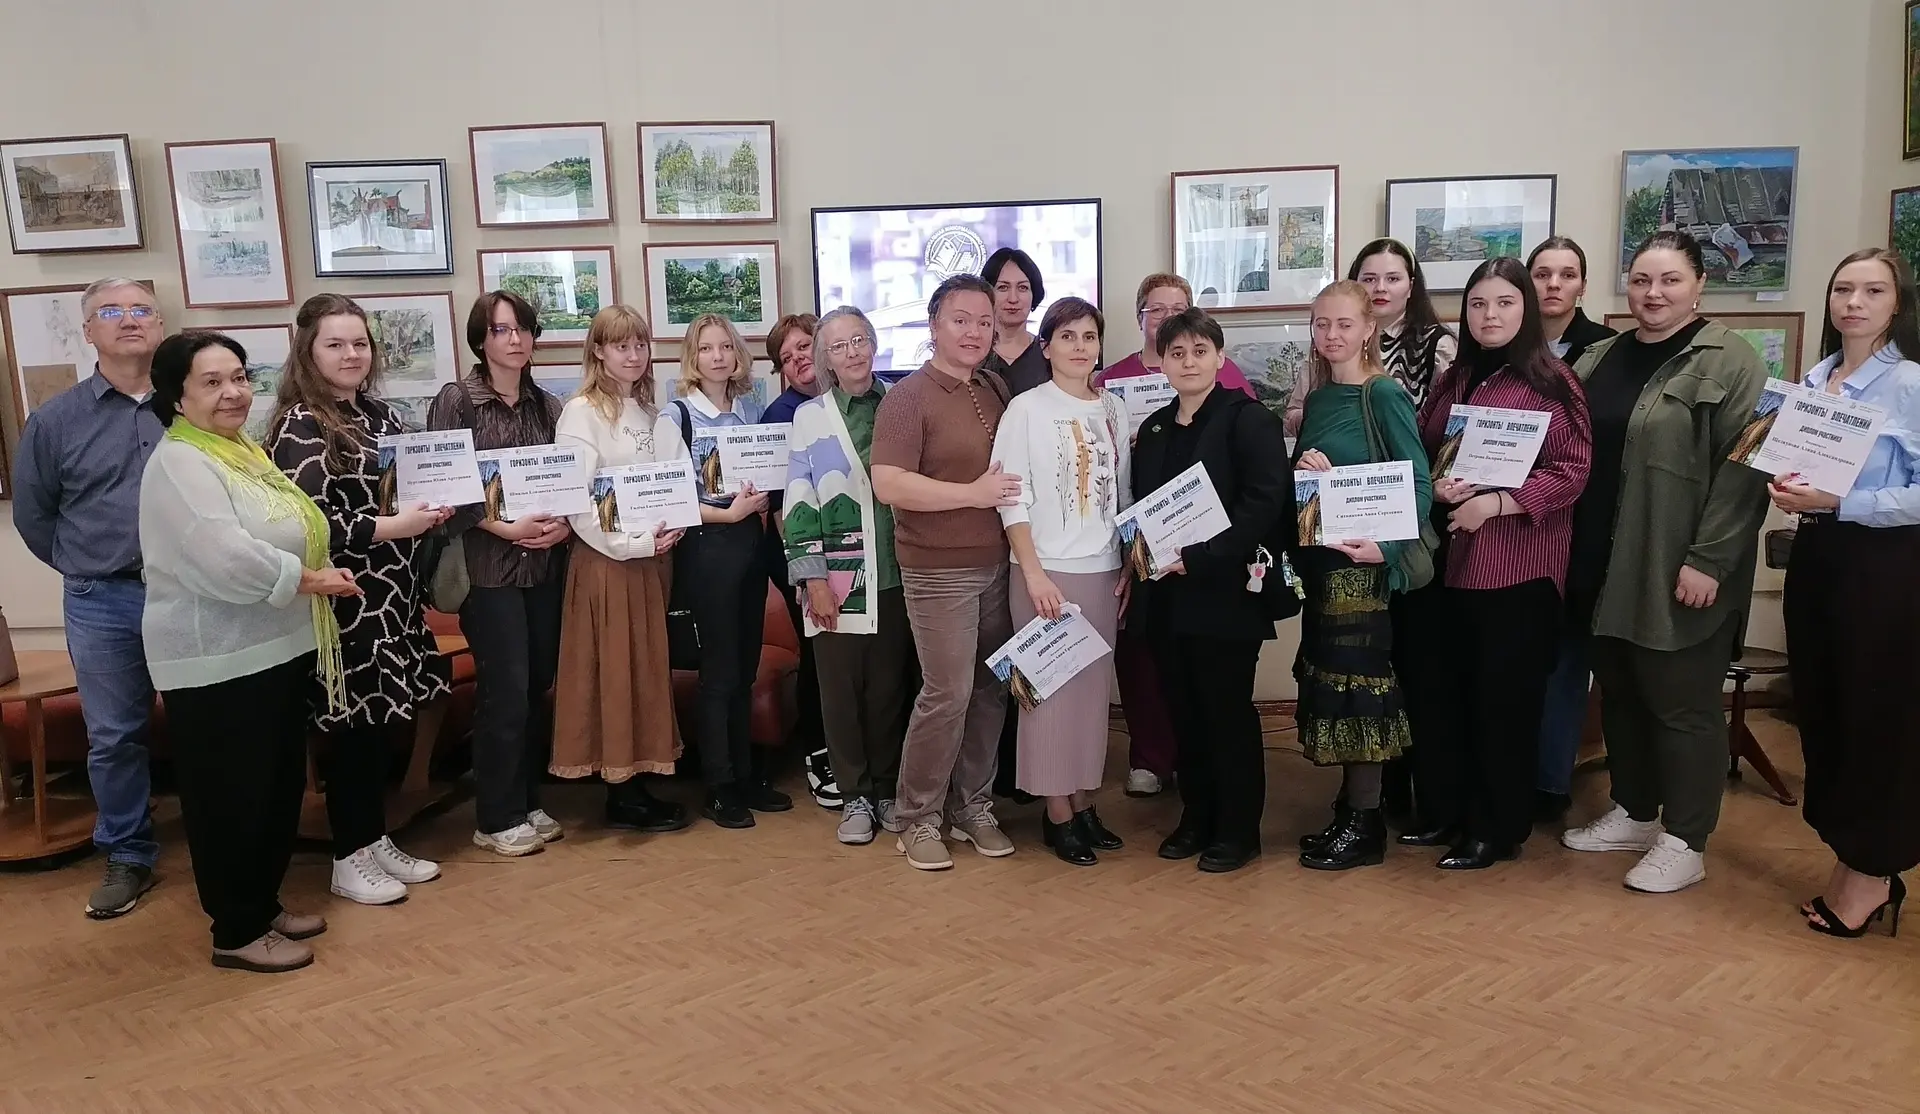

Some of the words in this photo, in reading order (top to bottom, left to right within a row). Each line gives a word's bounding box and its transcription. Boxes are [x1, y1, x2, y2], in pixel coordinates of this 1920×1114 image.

[1134, 384, 1159, 392] ГОРИЗОНТЫ
[1794, 401, 1828, 418] ГОРИЗОНТЫ
[1830, 410, 1872, 430] ВПЕЧАТЛЕНИЙ
[1476, 419, 1504, 429] ГОРИЗОНТЫ
[1506, 422, 1539, 433] ВПЕЧАТЛЕНИЙ
[727, 436, 753, 444] ГОРИЗОНТЫ
[757, 433, 786, 442] ВПЕЧАТЛЕНИЙ
[405, 444, 430, 454] ГОРИЗОНТЫ
[435, 440, 465, 451] ВПЕЧАТЛЕНИЙ
[510, 458, 538, 467] ГОРИЗОНТЫ
[543, 453, 575, 464] ВПЕЧАТЛЕНИЙ
[624, 474, 651, 484] ГОРИЗОНТЫ
[655, 469, 686, 480] ВПЕЧАТЛЕНИЙ
[1331, 478, 1361, 488] ГОРИЗОНТЫ
[1367, 473, 1404, 485] ВПЕЧАТЛЕНИЙ
[1145, 498, 1170, 518] ГОРИЗОНТЫ
[1171, 476, 1201, 500] ВПЕЧАТЛЕНИЙ
[1017, 631, 1042, 654] ГОРИЗОНТЫ
